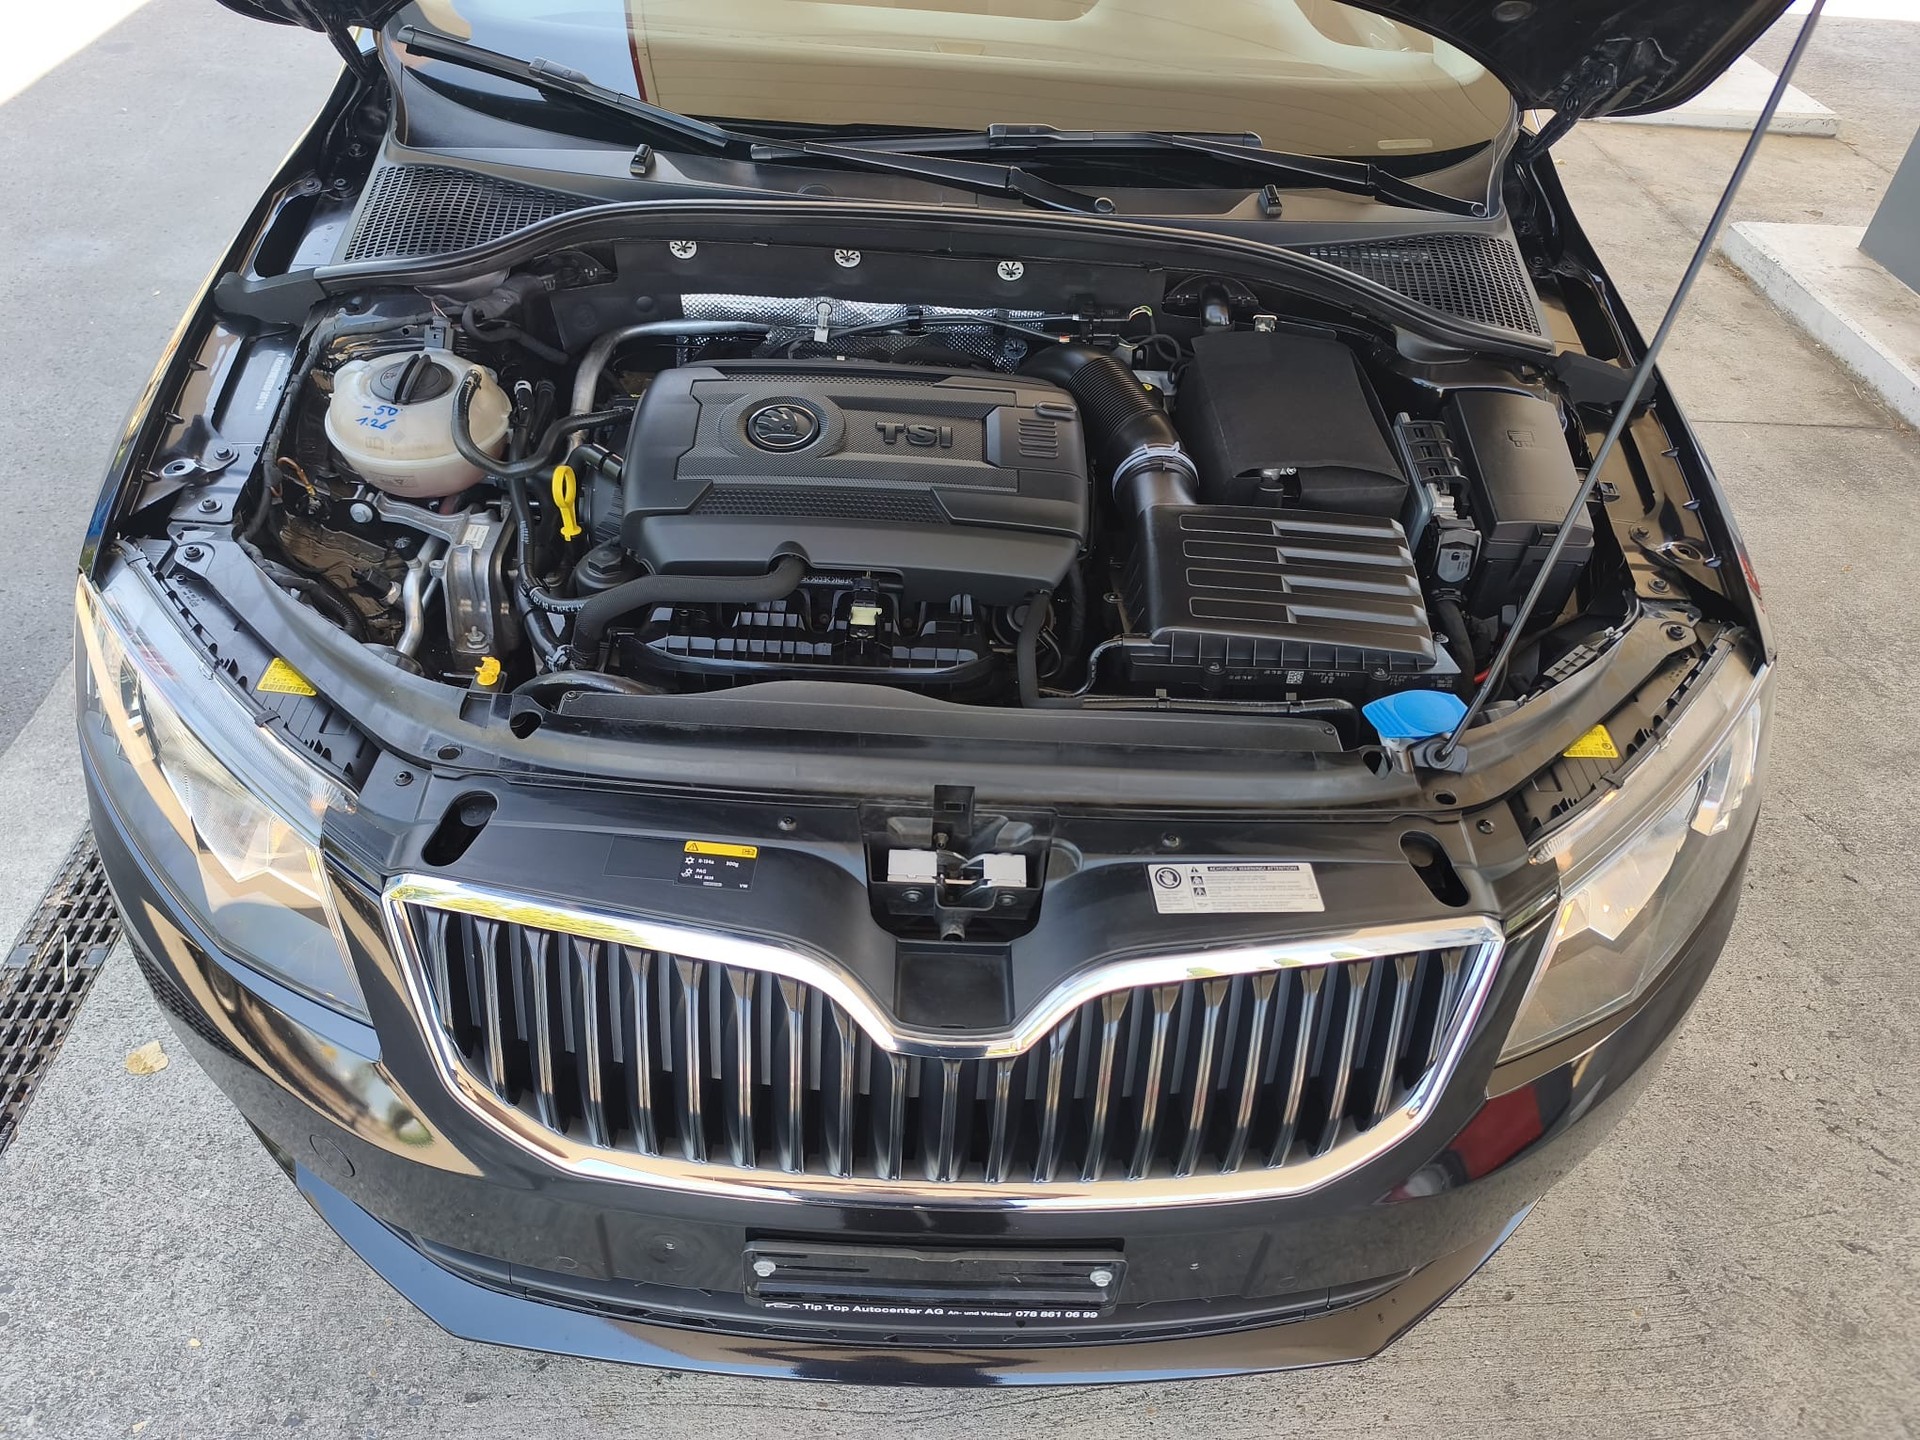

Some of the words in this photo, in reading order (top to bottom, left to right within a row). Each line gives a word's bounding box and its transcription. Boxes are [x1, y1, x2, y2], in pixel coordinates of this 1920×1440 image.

[875, 422, 953, 448] TSI
[802, 1303, 823, 1311] Tip
[825, 1304, 850, 1312] Top
[852, 1305, 923, 1314] Autocenter
[1082, 1311, 1099, 1319] 99
